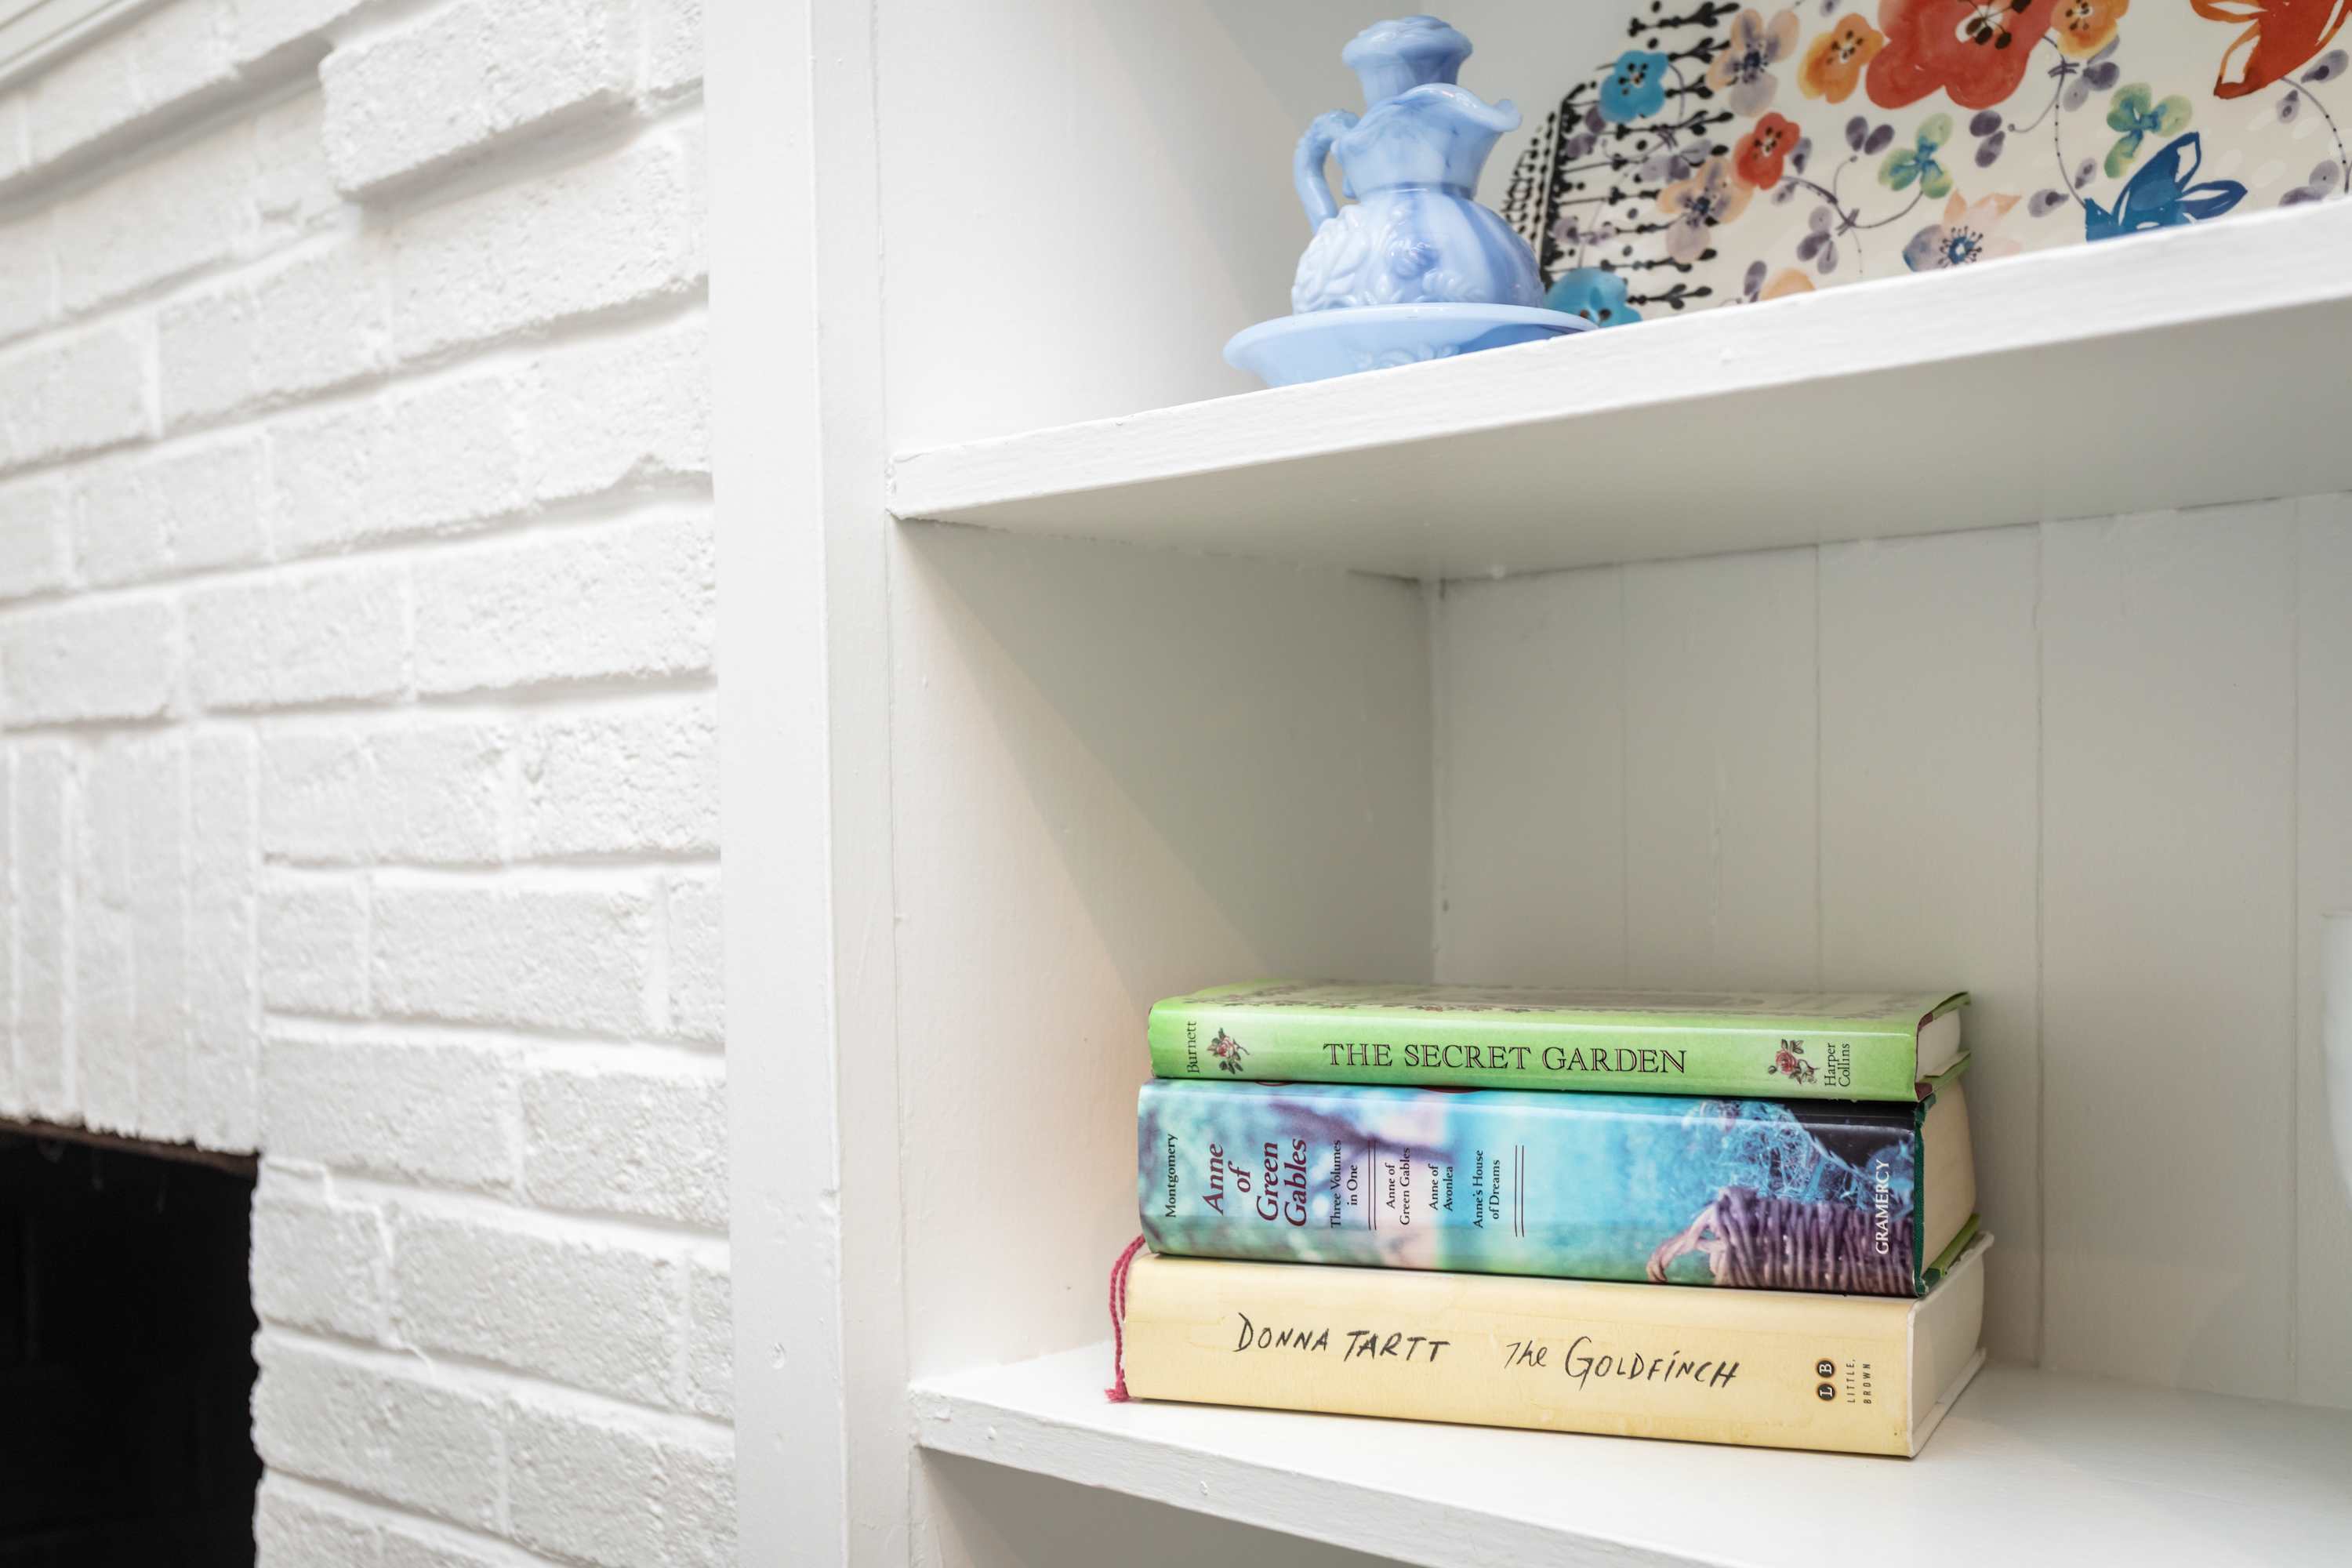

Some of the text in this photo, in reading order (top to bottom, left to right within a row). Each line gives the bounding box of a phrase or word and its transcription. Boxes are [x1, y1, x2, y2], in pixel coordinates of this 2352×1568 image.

[1186, 1021, 1200, 1074] Burnett
[1323, 1043, 1686, 1074] THE SECRET GARDEN
[1824, 1043, 1836, 1087] Harper
[1838, 1044, 1851, 1087] Collins
[1165, 1134, 1178, 1218] Montgomery
[1202, 1143, 1224, 1214] Anne
[1228, 1160, 1251, 1193] of
[1256, 1142, 1279, 1221] Green
[1284, 1138, 1307, 1227] Gables
[1330, 1139, 1341, 1229] Three Volumes
[1347, 1164, 1358, 1206] in One
[1385, 1163, 1396, 1209] Anne of
[1399, 1147, 1410, 1225] Green Gables
[1428, 1163, 1439, 1210] Anne of
[1443, 1166, 1454, 1211] Avonlea
[1472, 1149, 1483, 1229] Anne's House
[1489, 1160, 1501, 1220] of Dreams
[1876, 1160, 1890, 1254] GRAMERCY
[1232, 1312, 1450, 1362] DONNA TARTT
[1504, 1340, 1548, 1369] The
[1846, 1359, 1856, 1403] LITTLE,
[1862, 1363, 1872, 1404] BROWN
